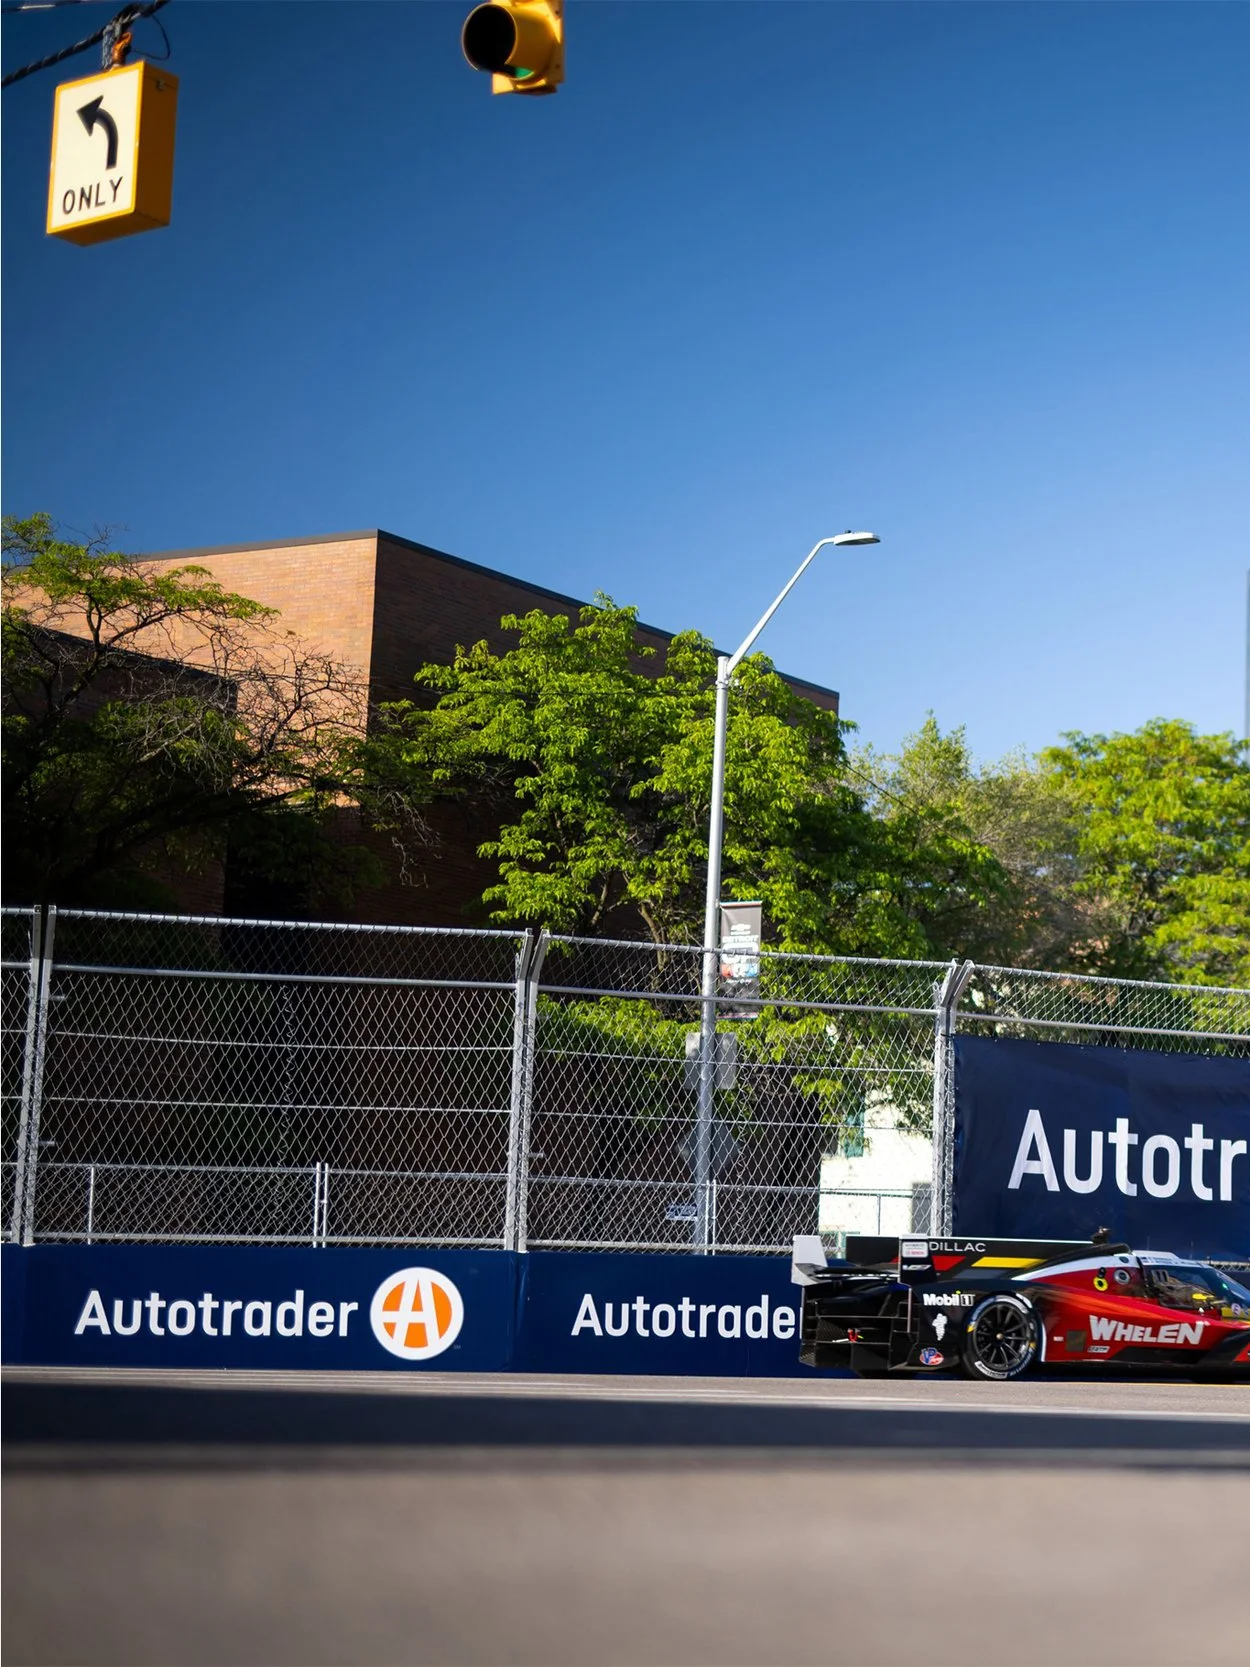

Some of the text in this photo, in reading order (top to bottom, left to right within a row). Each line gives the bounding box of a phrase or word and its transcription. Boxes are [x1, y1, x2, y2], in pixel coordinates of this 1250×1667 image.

[63, 176, 123, 215] ONLY
[929, 1241, 986, 1252] DILLAC
[74, 1290, 358, 1337] Autotrader
[571, 1293, 803, 1339] Autotrade
[923, 1291, 959, 1306] Mobil
